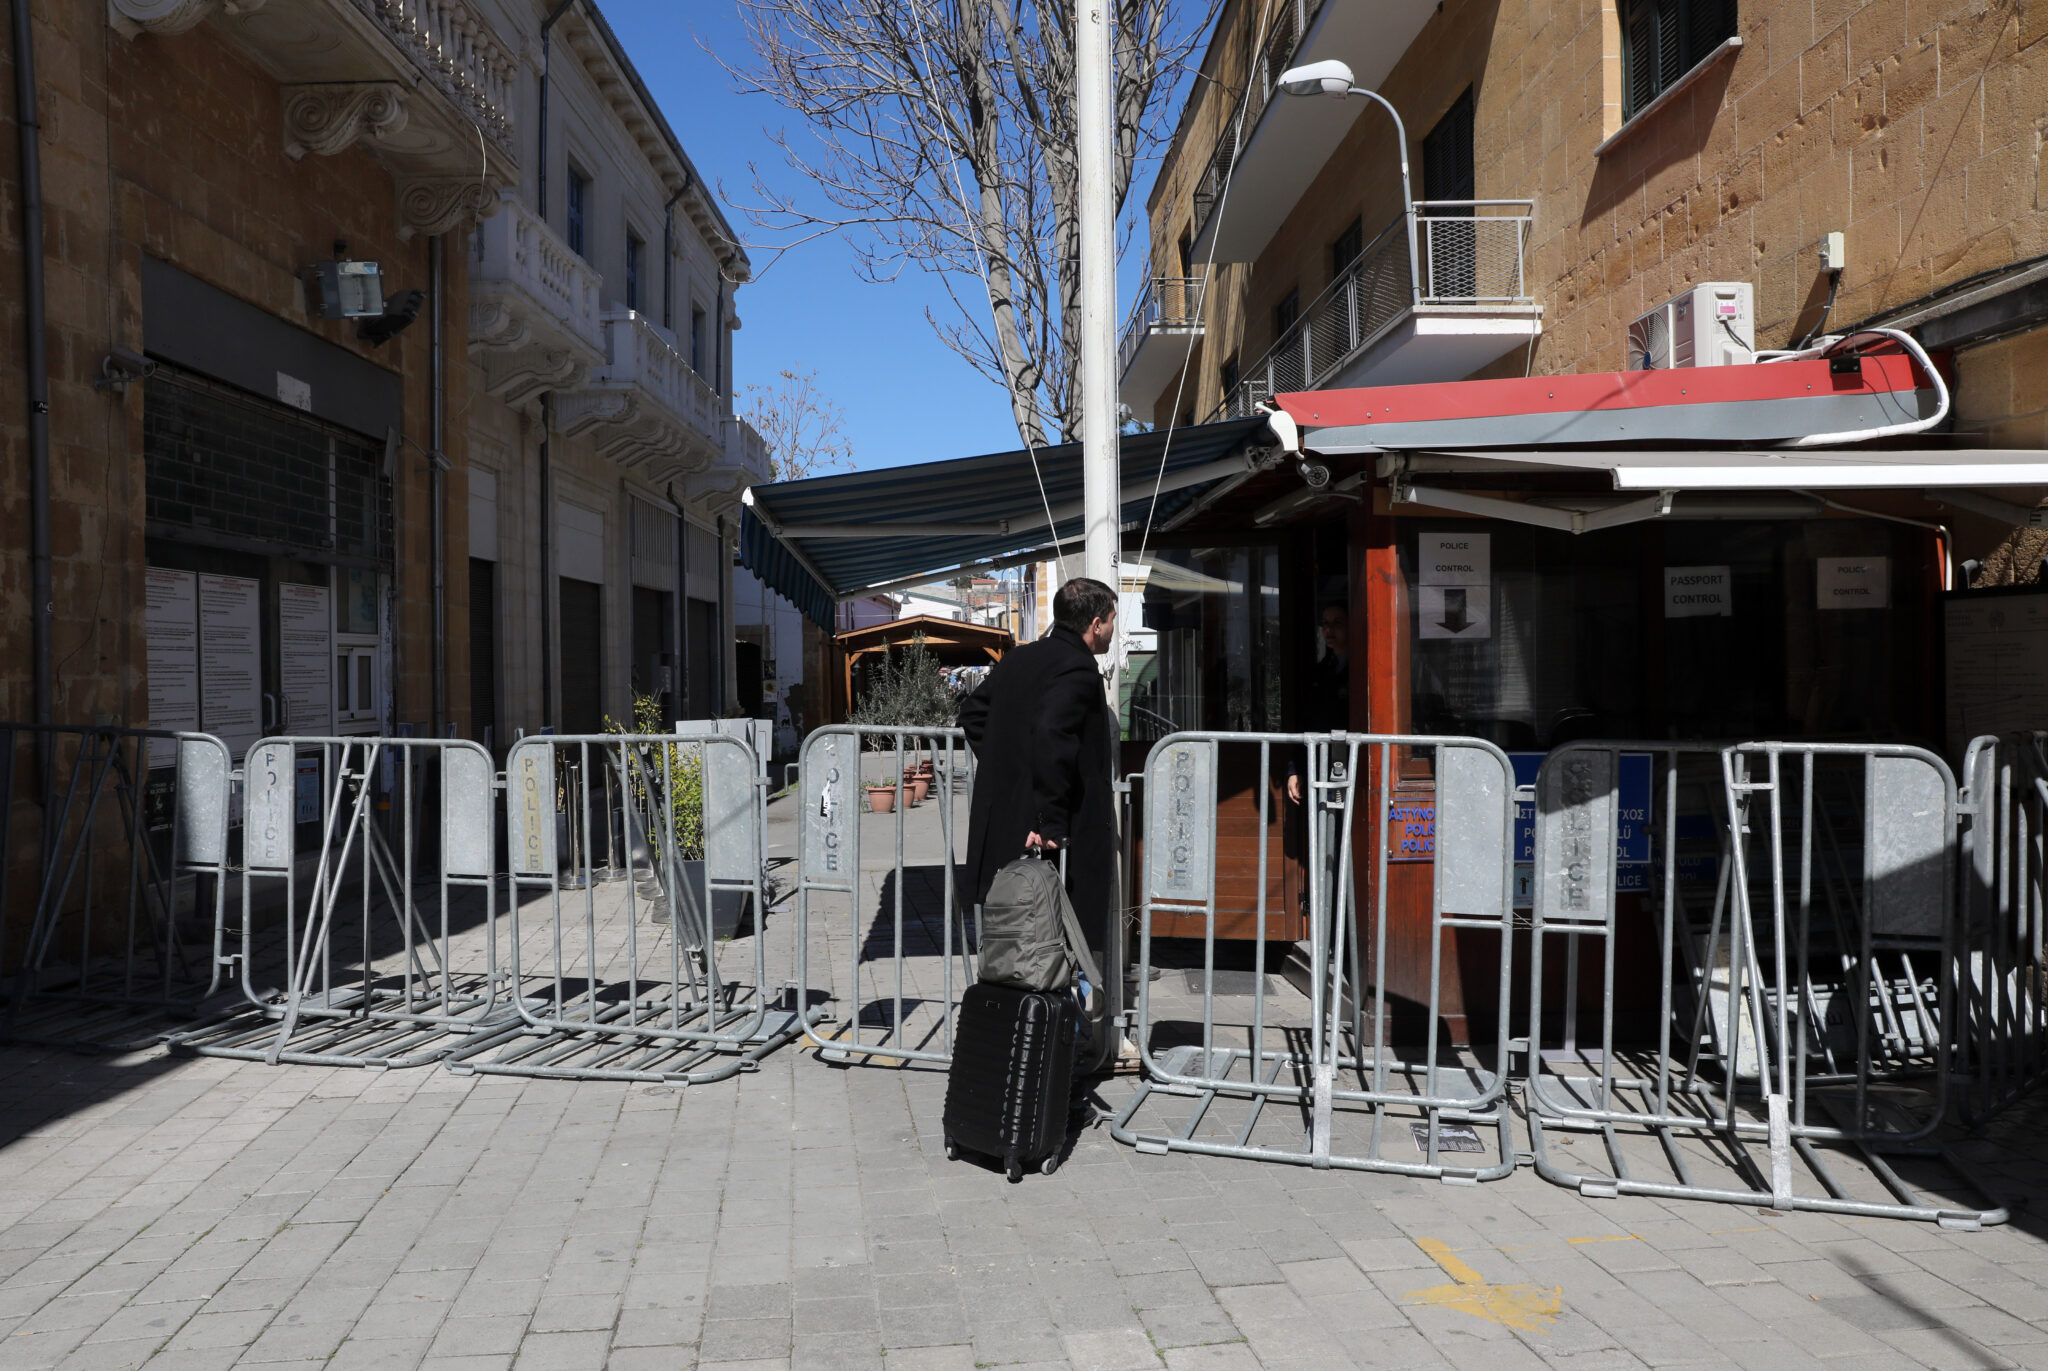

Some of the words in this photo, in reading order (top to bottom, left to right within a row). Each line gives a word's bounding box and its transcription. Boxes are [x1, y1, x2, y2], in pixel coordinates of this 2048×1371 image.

[1440, 542, 1469, 550] POLICE
[1435, 565, 1474, 573] CONTROL
[1671, 575, 1723, 586] PASSPORT
[1673, 594, 1723, 604] CONTROL
[524, 758, 539, 869] POLICE
[1173, 751, 1190, 887] POLICE
[1401, 839, 1435, 851] POLIC
